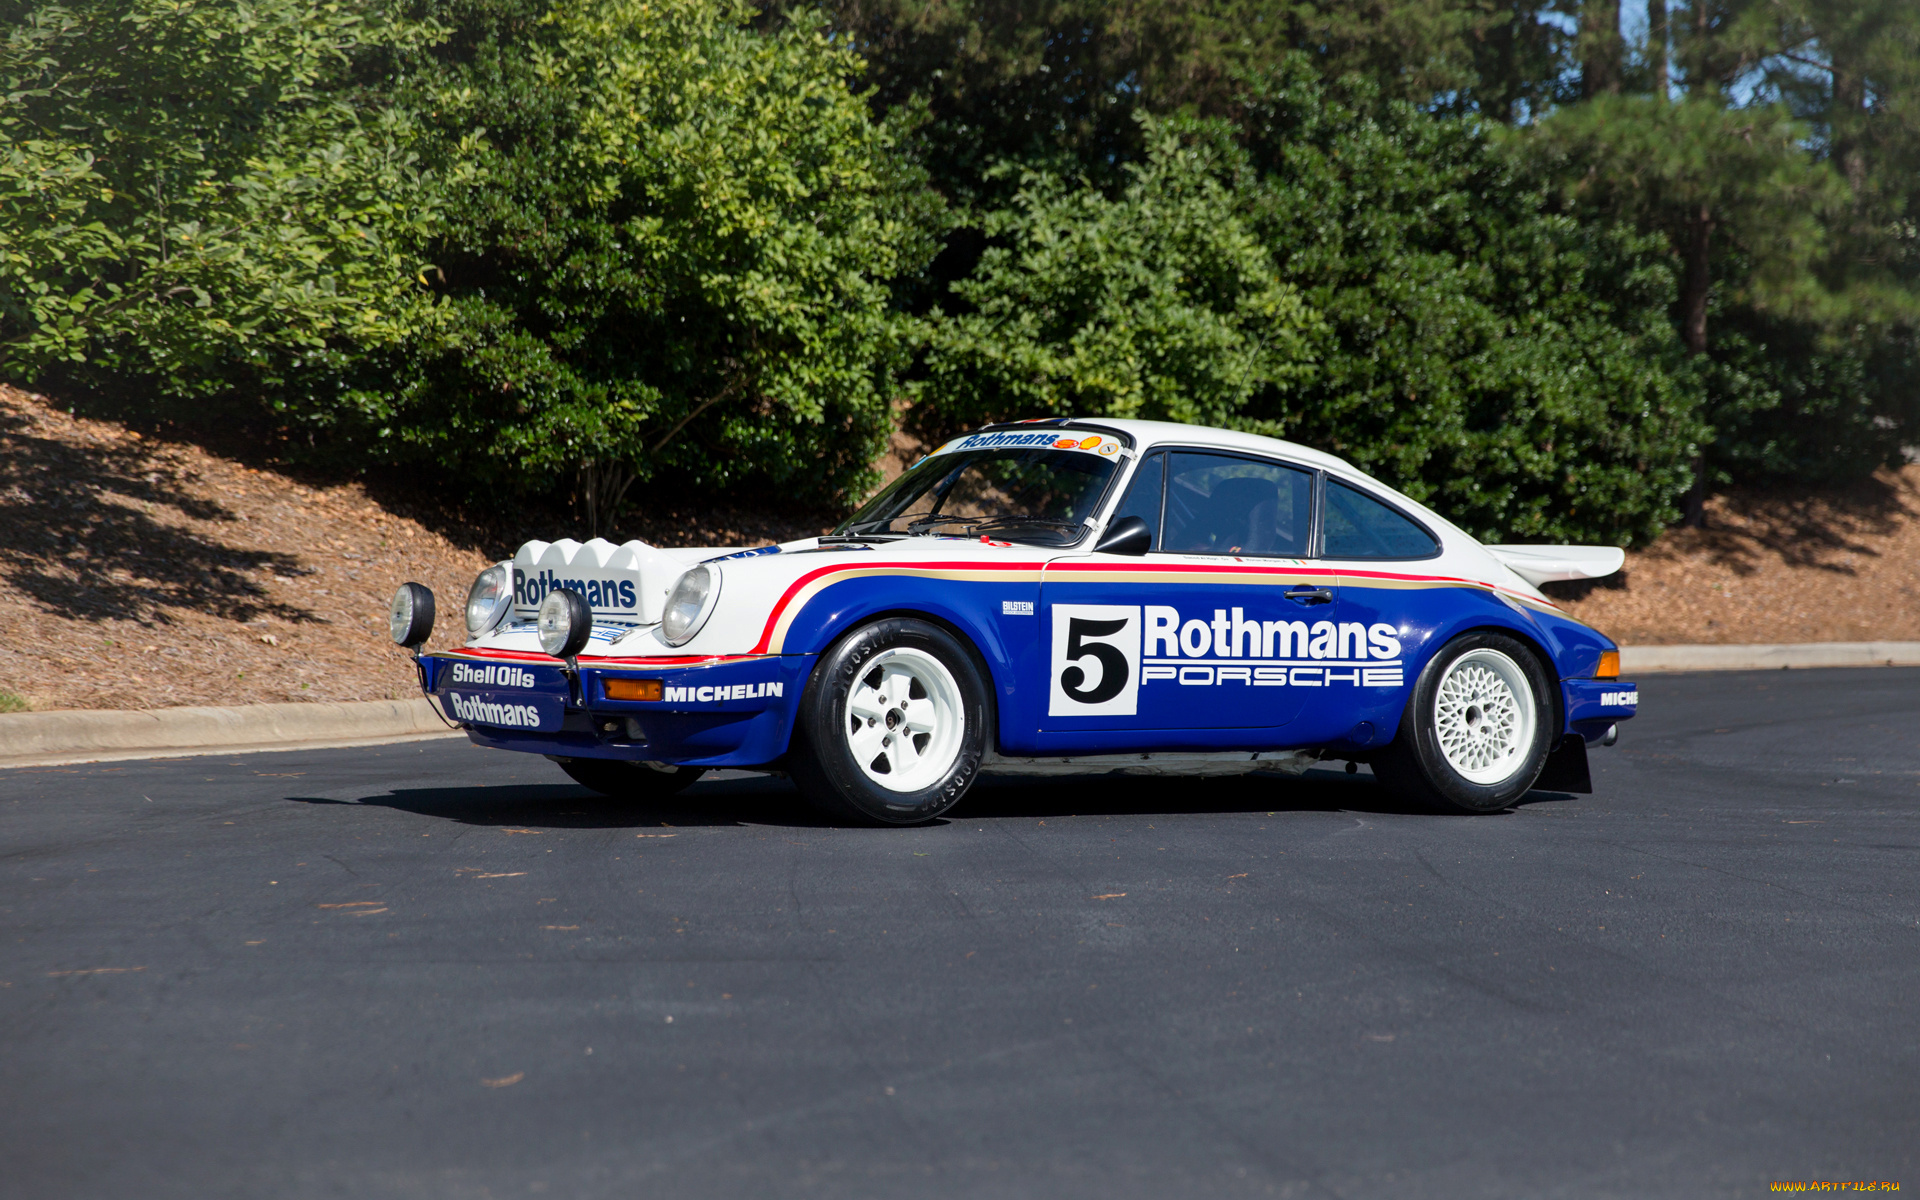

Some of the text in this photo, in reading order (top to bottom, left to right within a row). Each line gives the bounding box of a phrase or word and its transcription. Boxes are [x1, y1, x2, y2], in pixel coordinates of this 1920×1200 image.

[955, 431, 1060, 449] Rothmans
[1002, 600, 1034, 611] BILSTEIN
[1144, 605, 1402, 659] Rothmans
[1060, 617, 1130, 704] 5
[452, 663, 535, 688] Shell Oils
[1142, 666, 1404, 687] PORSCHE
[665, 682, 784, 702] MICHELIN
[450, 692, 541, 727] Rothmans
